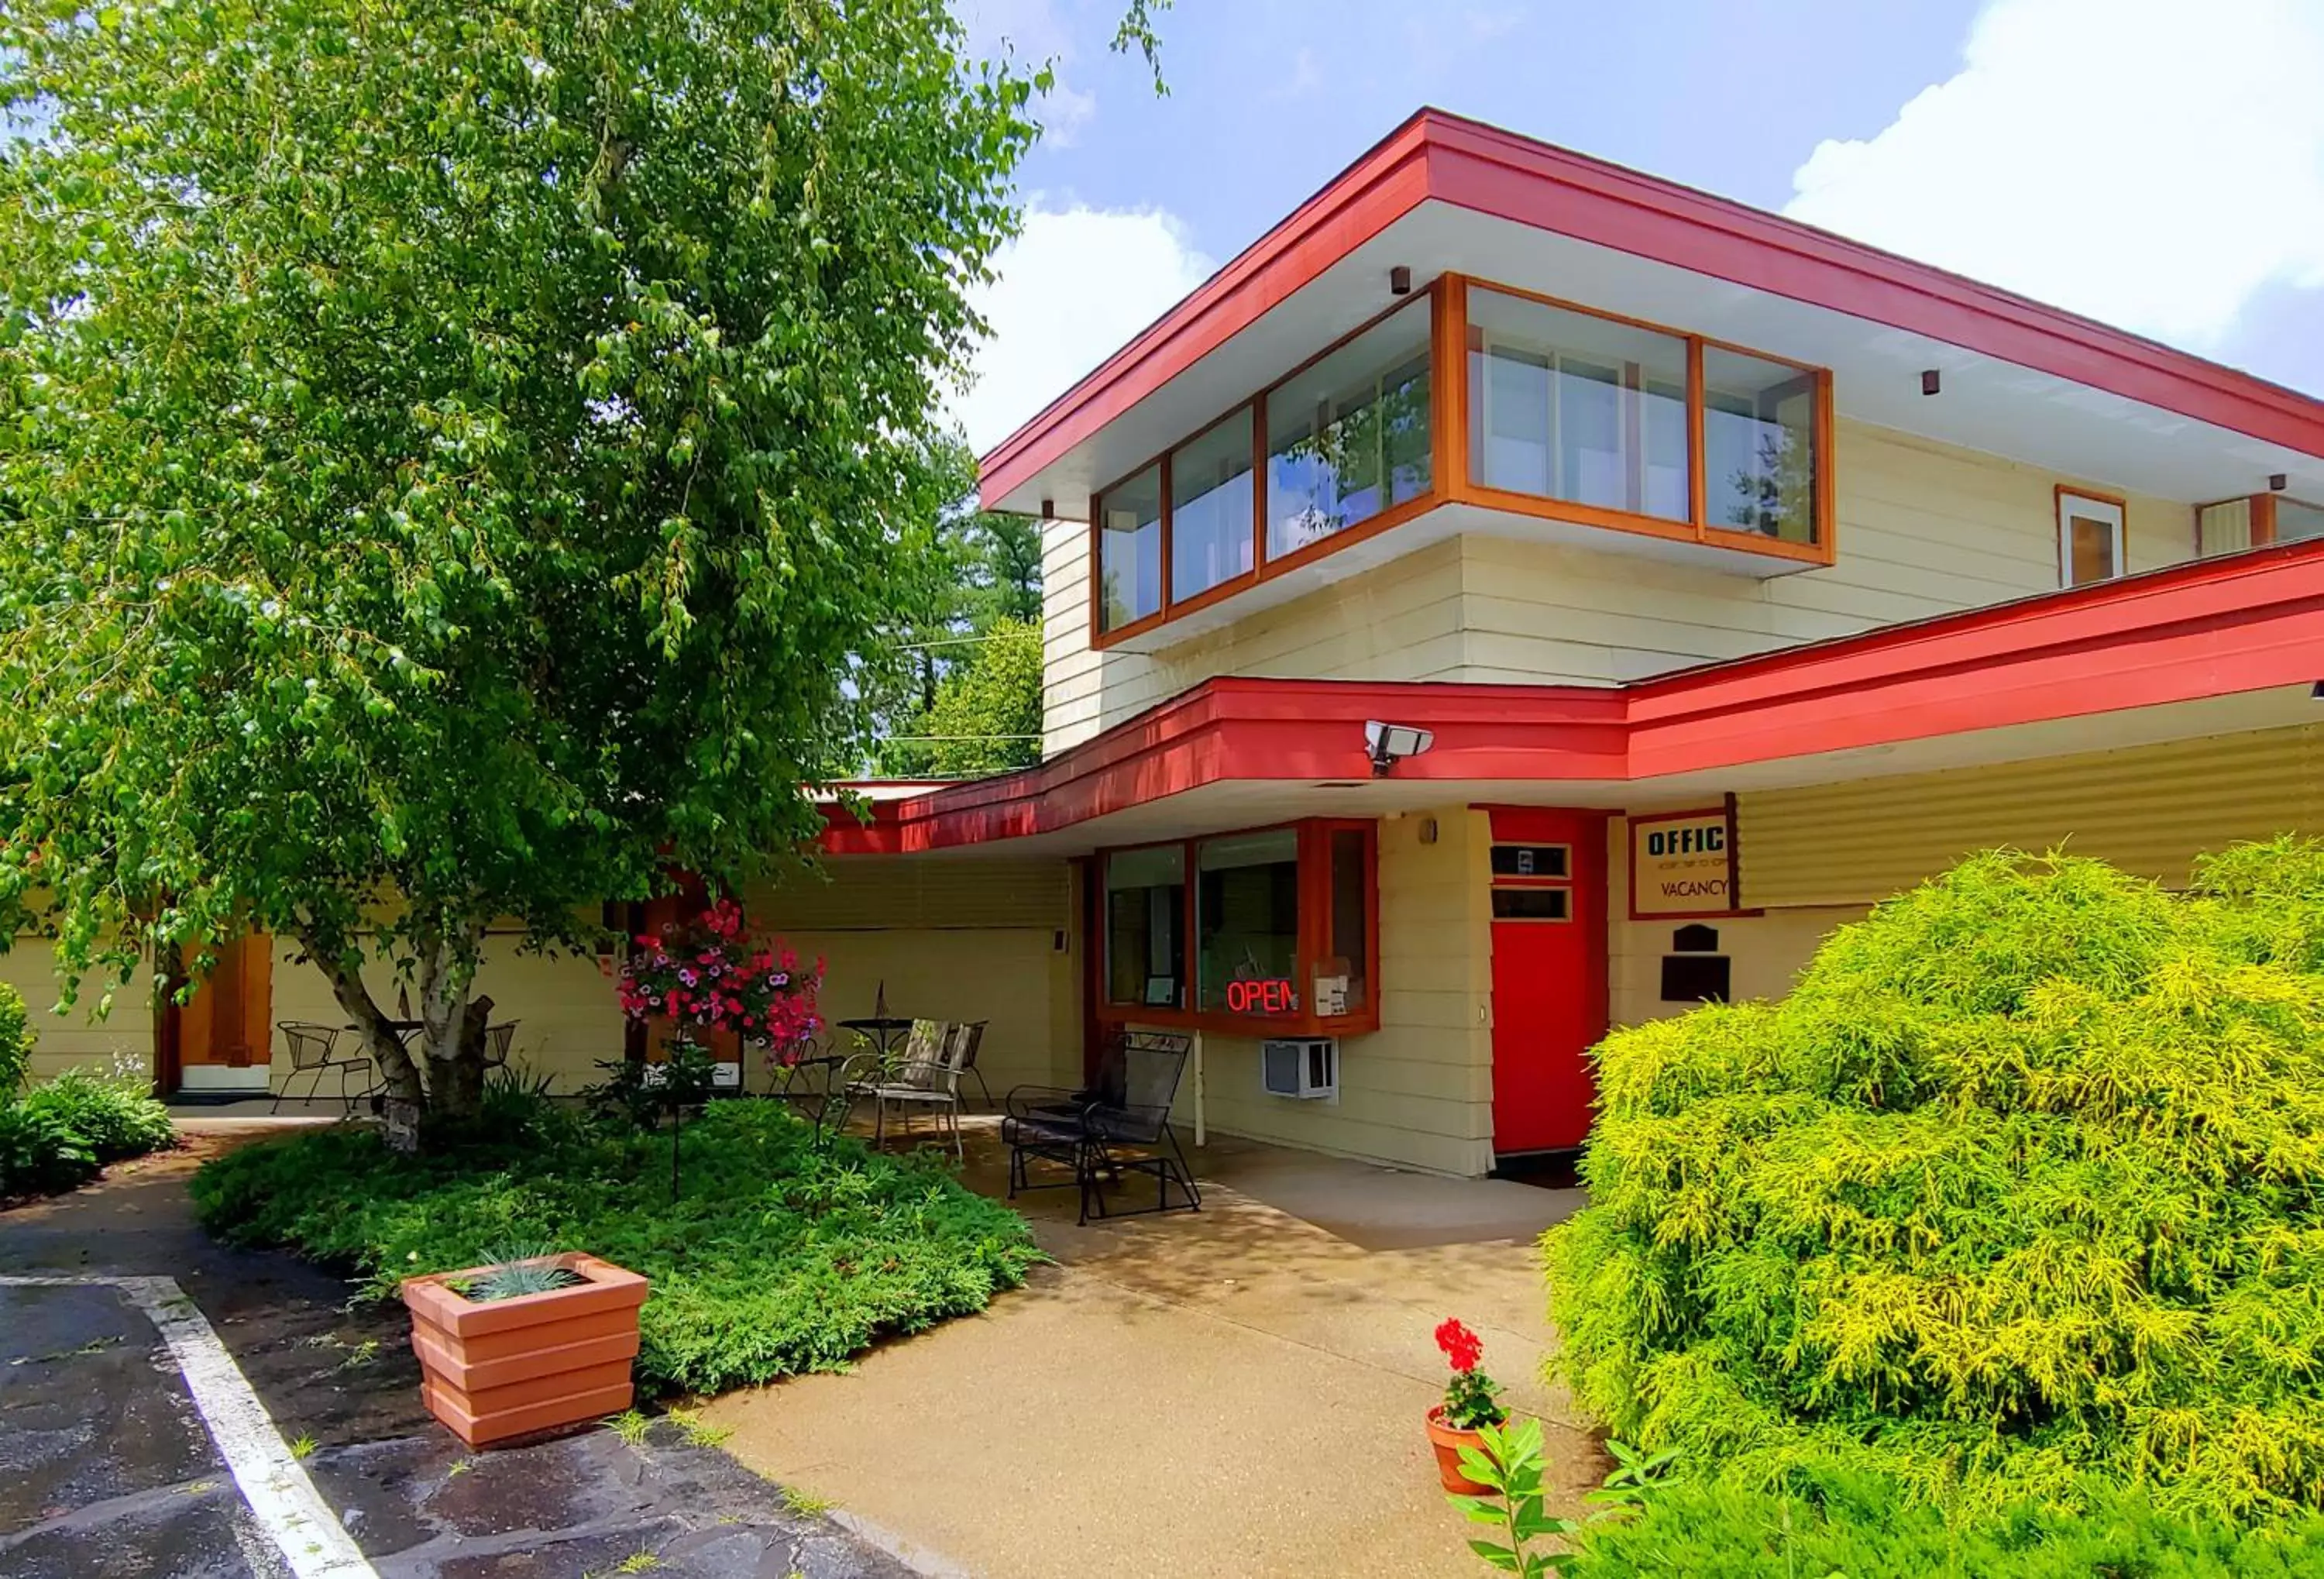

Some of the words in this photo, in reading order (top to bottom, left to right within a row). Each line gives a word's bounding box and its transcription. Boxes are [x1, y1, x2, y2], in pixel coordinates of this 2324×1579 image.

[1648, 826, 1724, 856] OFFIC
[1661, 879, 1728, 896] VACANCY
[1227, 980, 1293, 1012] OPEN
